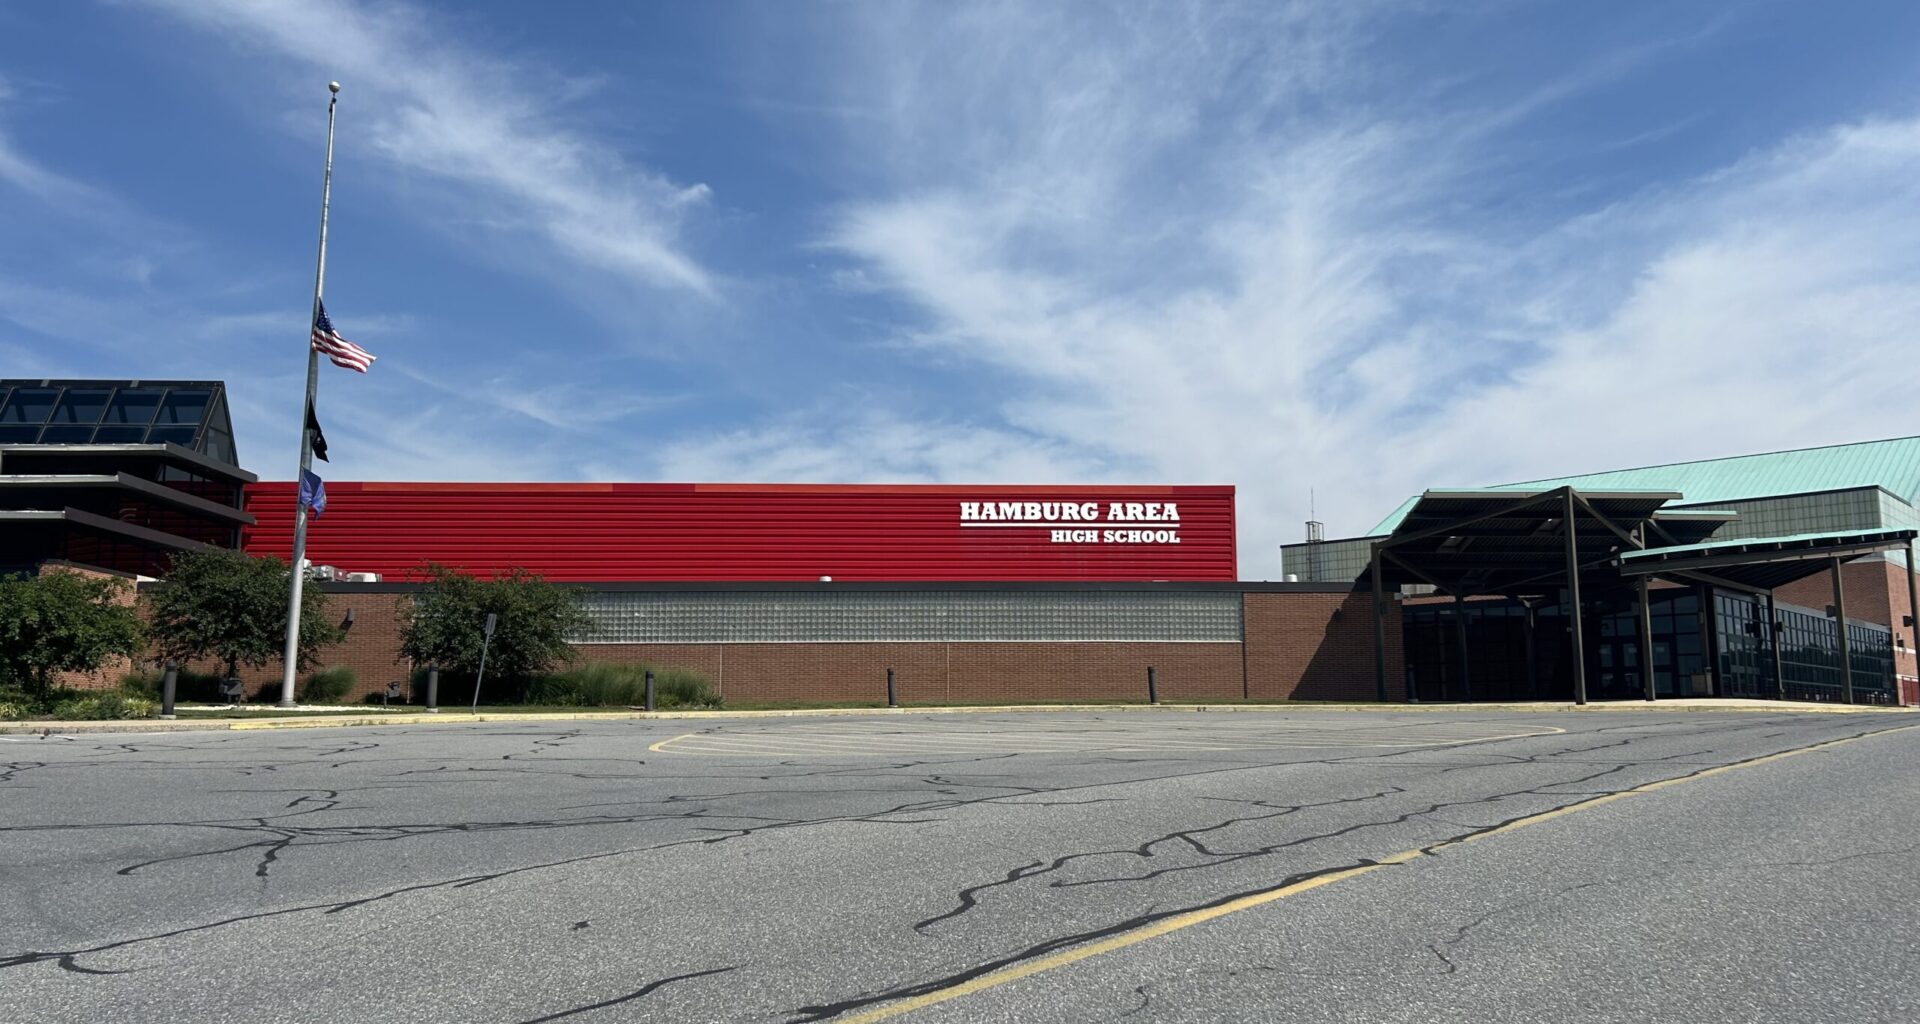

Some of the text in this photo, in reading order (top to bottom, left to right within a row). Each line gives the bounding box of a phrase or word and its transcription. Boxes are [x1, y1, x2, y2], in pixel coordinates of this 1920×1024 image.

[960, 502, 1180, 520] HAMBURG AREA
[1051, 530, 1180, 543] HIGH SCHOOL
